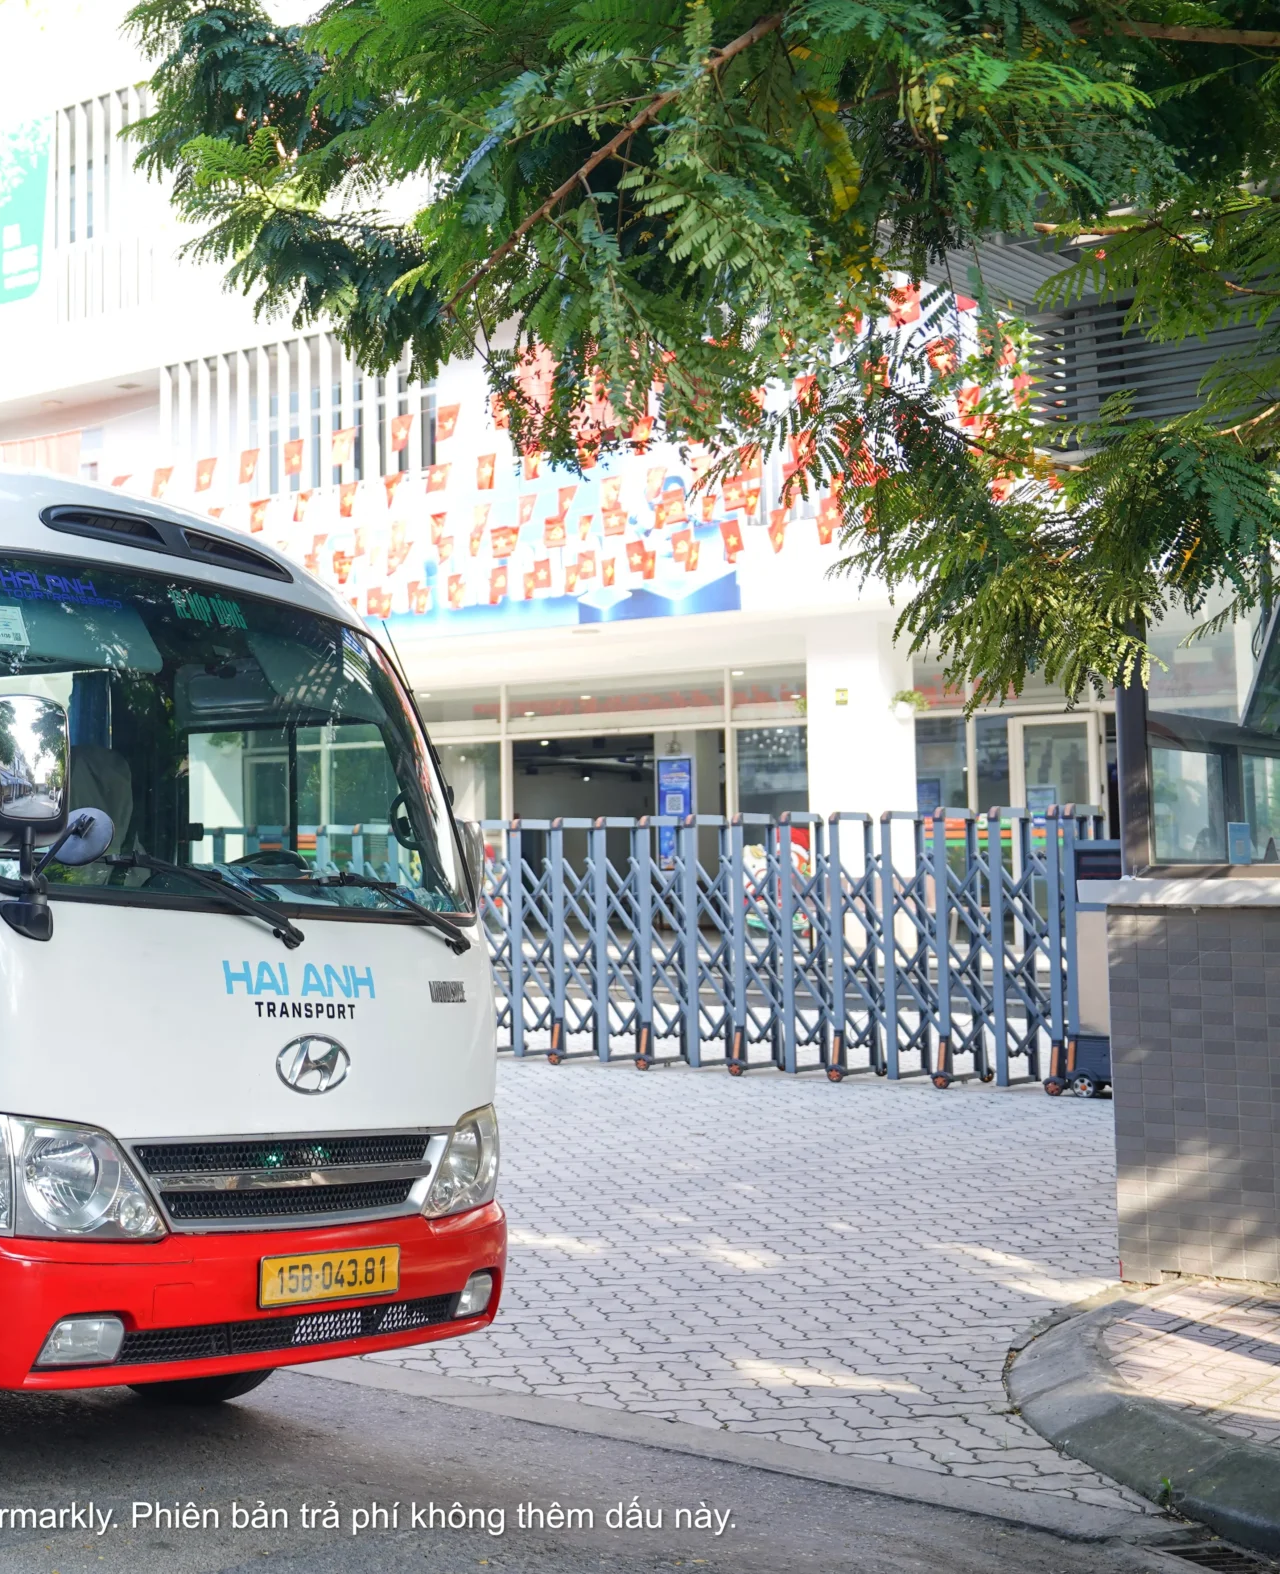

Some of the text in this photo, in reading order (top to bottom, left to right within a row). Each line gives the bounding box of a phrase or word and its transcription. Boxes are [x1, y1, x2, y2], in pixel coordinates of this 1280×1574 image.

[45, 574, 97, 597] ANH
[222, 960, 376, 999] HAI ANH
[255, 1001, 355, 1020] TRANSPORT
